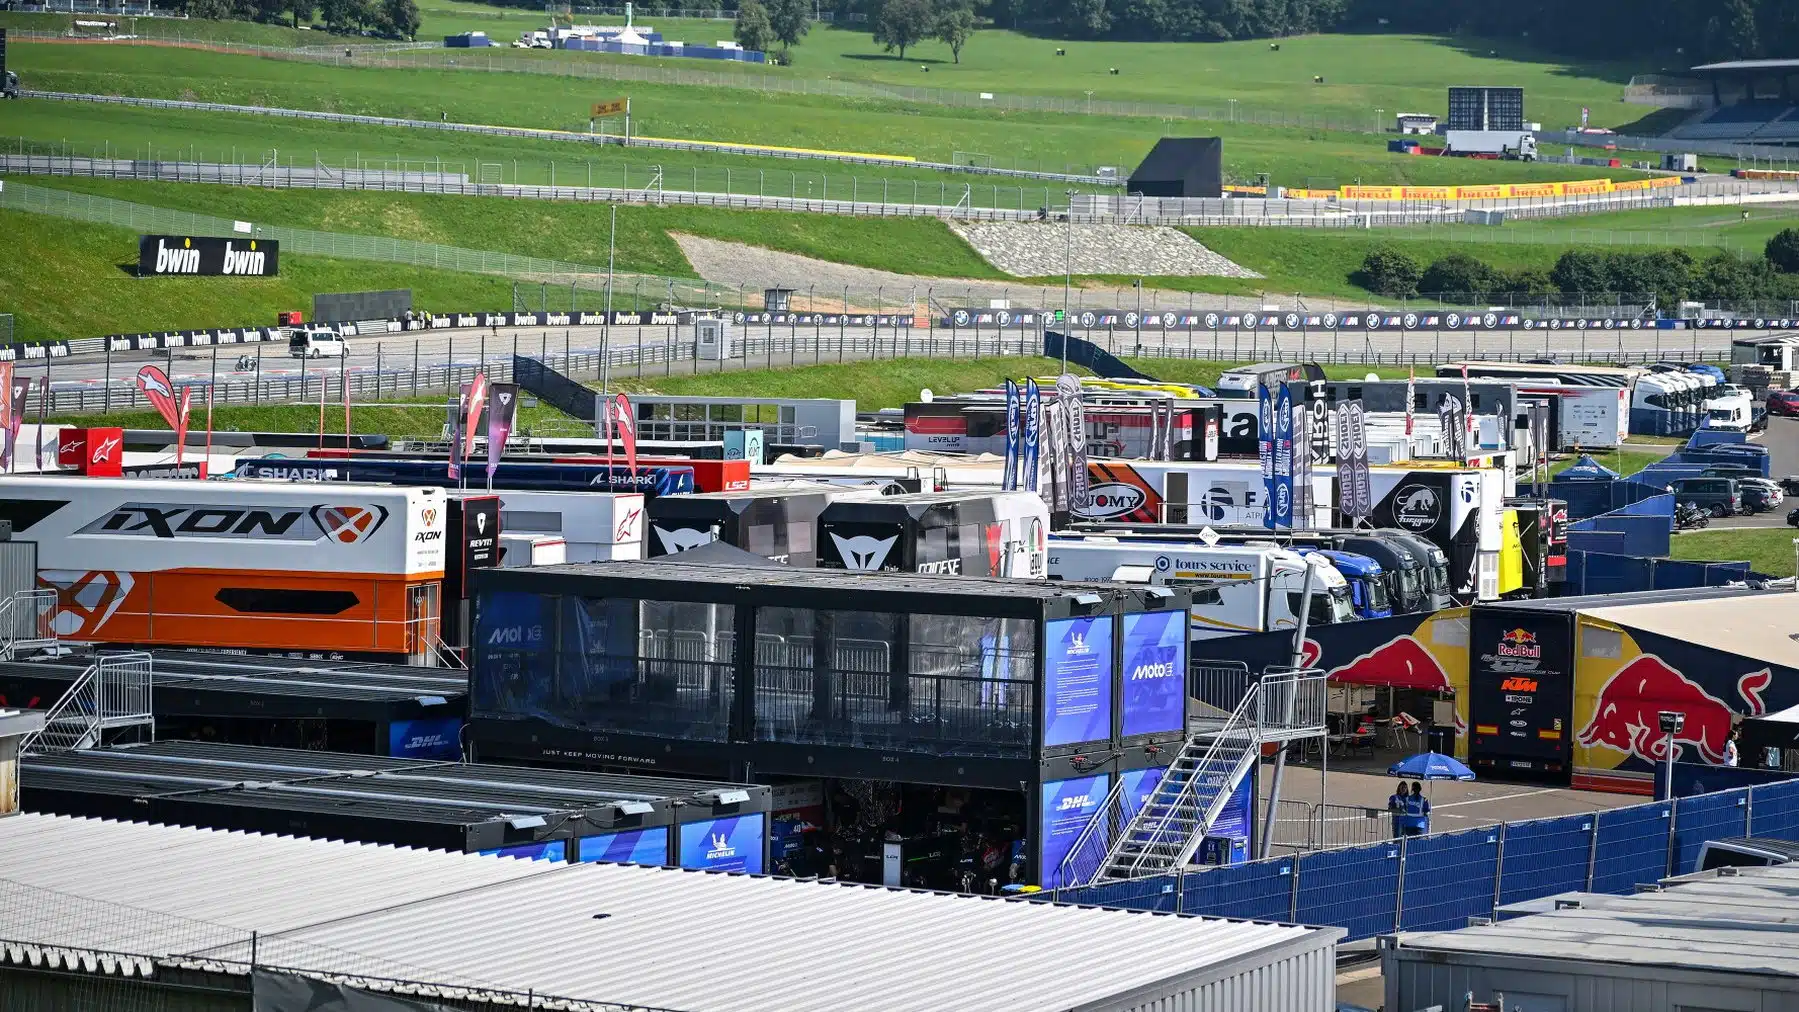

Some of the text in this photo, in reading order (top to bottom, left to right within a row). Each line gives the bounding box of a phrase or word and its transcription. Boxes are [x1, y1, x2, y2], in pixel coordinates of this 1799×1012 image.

[156, 238, 200, 273] bwin
[222, 240, 265, 275] bwin
[432, 314, 450, 328] bwin
[458, 313, 477, 327] bwin
[514, 312, 537, 326] bwin
[547, 312, 570, 326] bwin
[580, 312, 604, 325] bwin
[615, 312, 641, 325] bwin
[651, 312, 677, 325] bwin
[138, 333, 157, 349] bwin
[164, 331, 184, 347] bwin
[192, 330, 211, 346] bwin
[217, 329, 236, 344] bwin
[243, 327, 261, 342] bwin
[50, 341, 67, 357] win
[110, 335, 130, 351] bwin
[0, 345, 15, 361] win
[24, 342, 45, 359] bwin
[609, 475, 651, 485] SHARK
[725, 481, 748, 490] LS2
[1176, 559, 1252, 572] tours service
[1498, 642, 1541, 657] Red Bull
[1501, 677, 1537, 692] KTM
[410, 736, 445, 749] DHL
[617, 755, 656, 764] FORWARD
[1061, 795, 1091, 808] DHL
[706, 849, 735, 860] MICHELIN
